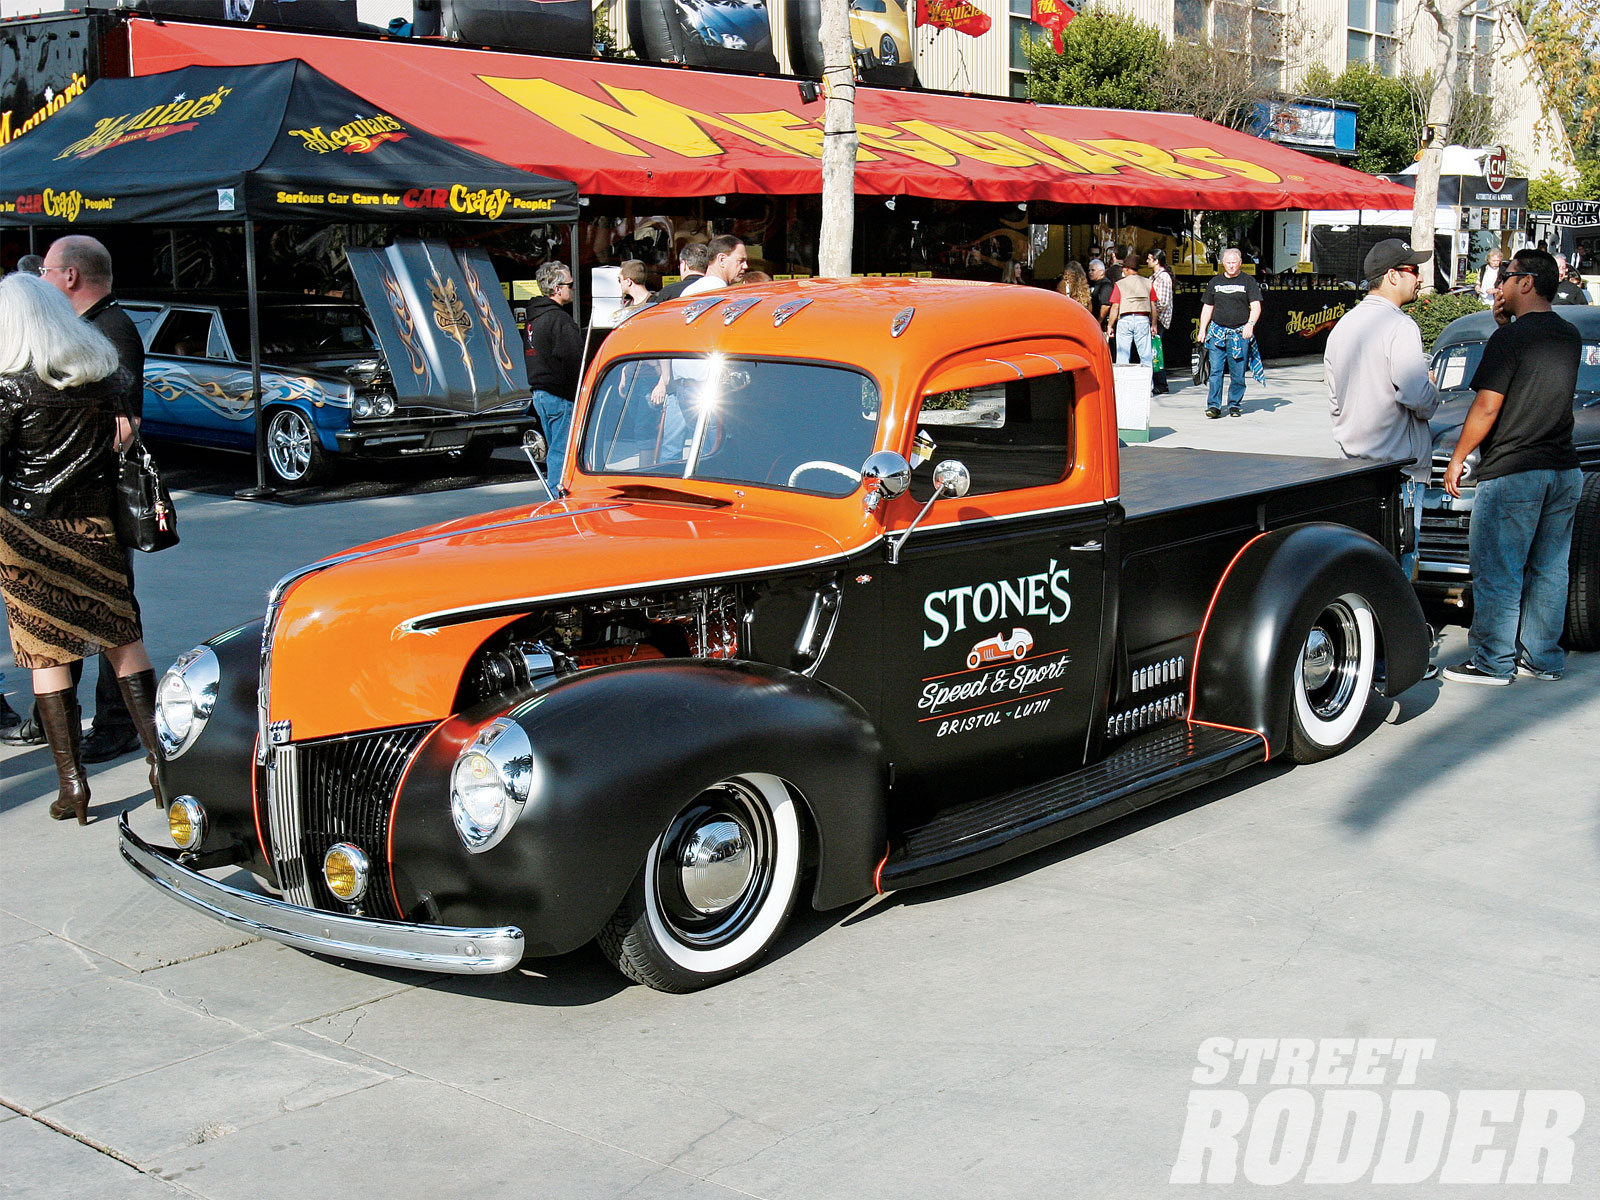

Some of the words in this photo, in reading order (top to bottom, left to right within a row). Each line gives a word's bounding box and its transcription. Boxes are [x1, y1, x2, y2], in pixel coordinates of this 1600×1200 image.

[287, 113, 402, 154] Meguiar's
[475, 74, 1284, 184] MEGUIARS
[16, 194, 42, 214] CAR
[43, 187, 82, 222] Crazy
[276, 191, 325, 204] Serious
[327, 192, 350, 204] Car
[352, 193, 380, 204] Care
[382, 193, 400, 205] for
[402, 188, 449, 208] CAR
[450, 184, 511, 220] Crazy
[513, 198, 552, 211] People!
[1554, 202, 1599, 213] COUNTY
[1555, 215, 1599, 225] ANGELS
[1285, 302, 1346, 336] Meguiar's
[923, 558, 1071, 650] STONE'S
[917, 673, 989, 714] Speed
[990, 669, 1008, 693] &
[1009, 656, 1070, 694] Sport
[936, 710, 1002, 737] BRISTOL
